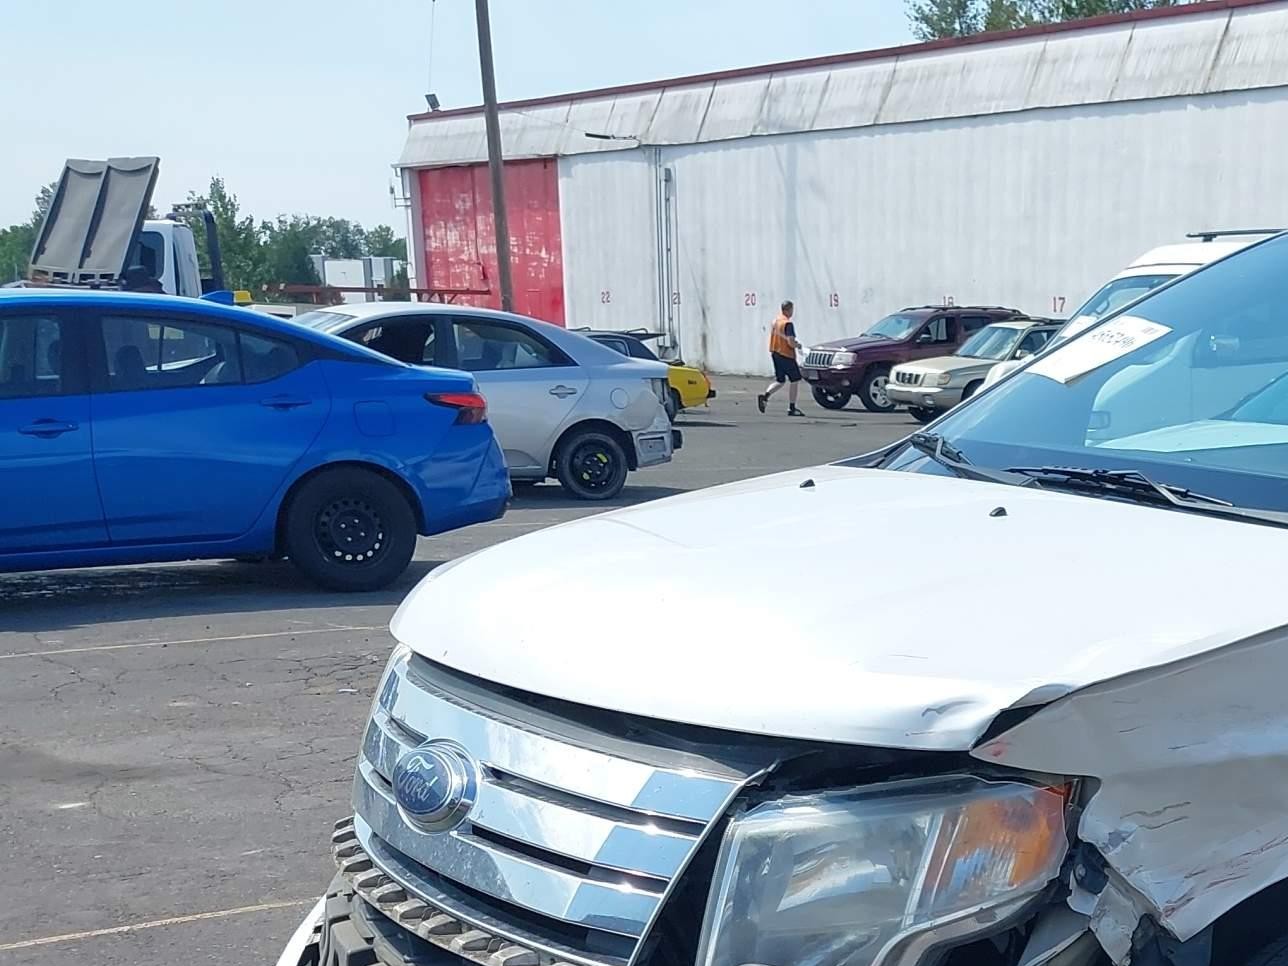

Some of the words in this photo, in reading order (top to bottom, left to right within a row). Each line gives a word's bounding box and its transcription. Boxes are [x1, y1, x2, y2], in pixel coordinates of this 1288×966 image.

[601, 291, 611, 304] 22
[744, 293, 757, 306] 20
[1053, 296, 1066, 313] 17
[397, 755, 439, 803] Ford
